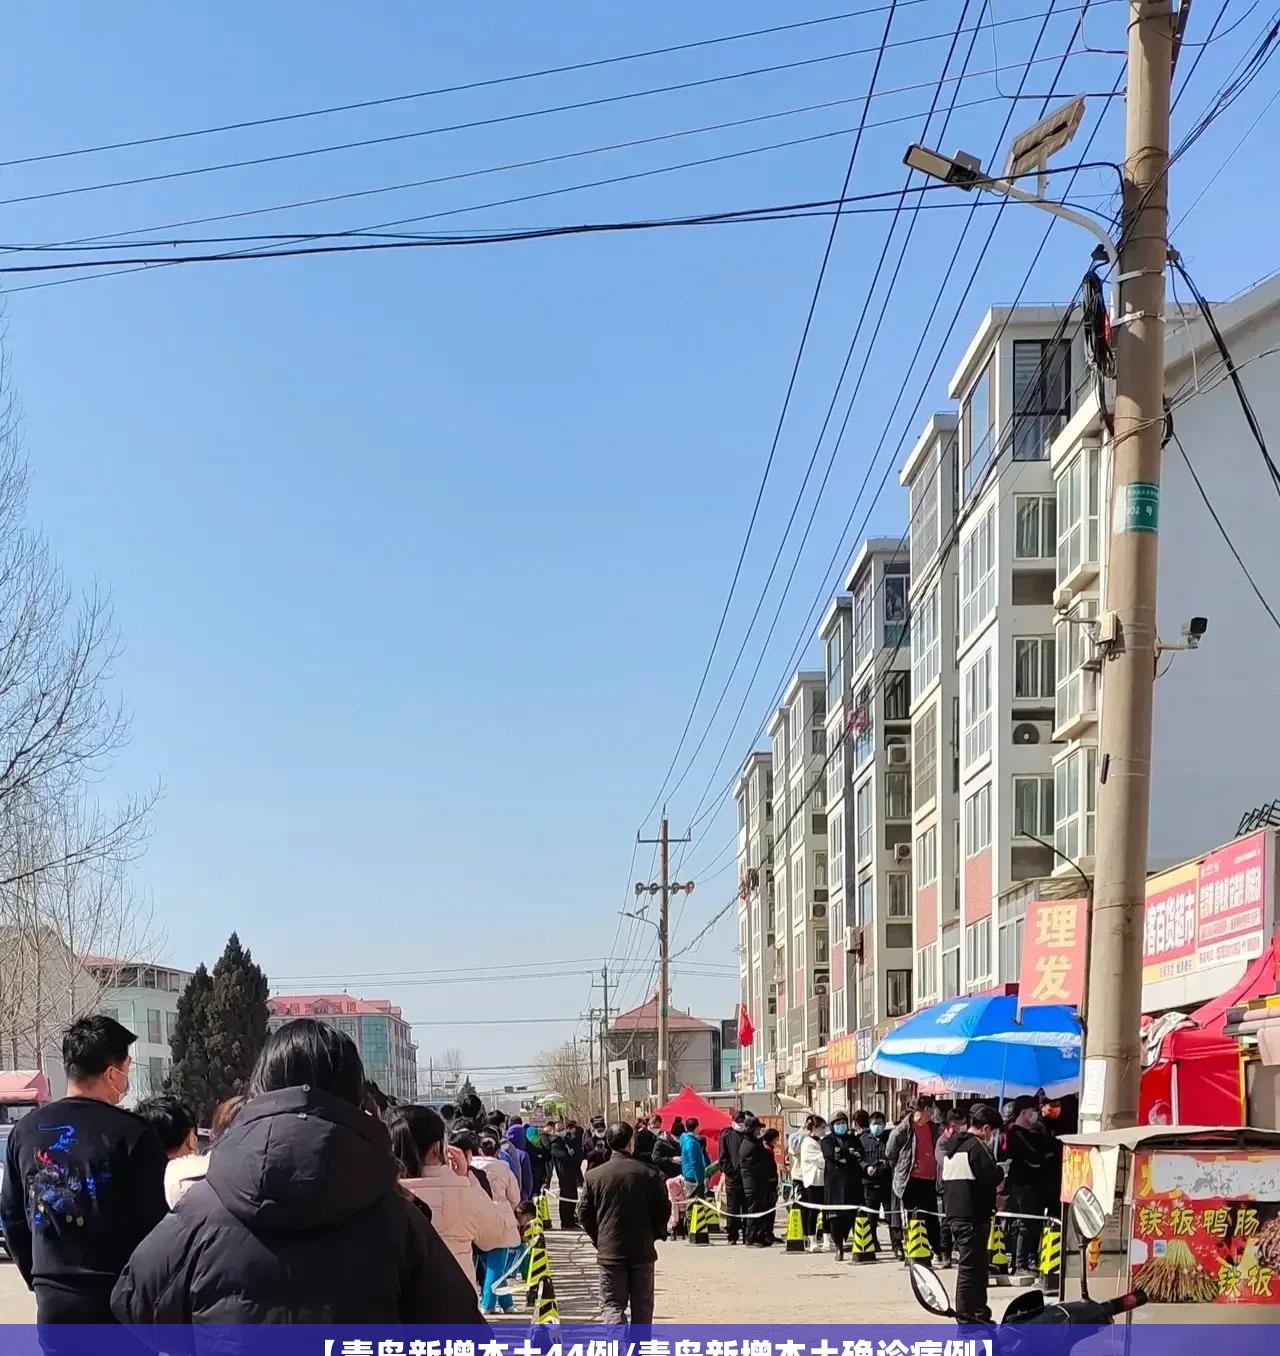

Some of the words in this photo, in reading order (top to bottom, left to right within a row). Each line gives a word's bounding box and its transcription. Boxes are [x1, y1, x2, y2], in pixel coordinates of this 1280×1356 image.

[1031, 904, 1078, 1002] 理发
[1138, 1207, 1261, 1238] 铁板鸭肠
[1217, 1265, 1273, 1298] 铁板
